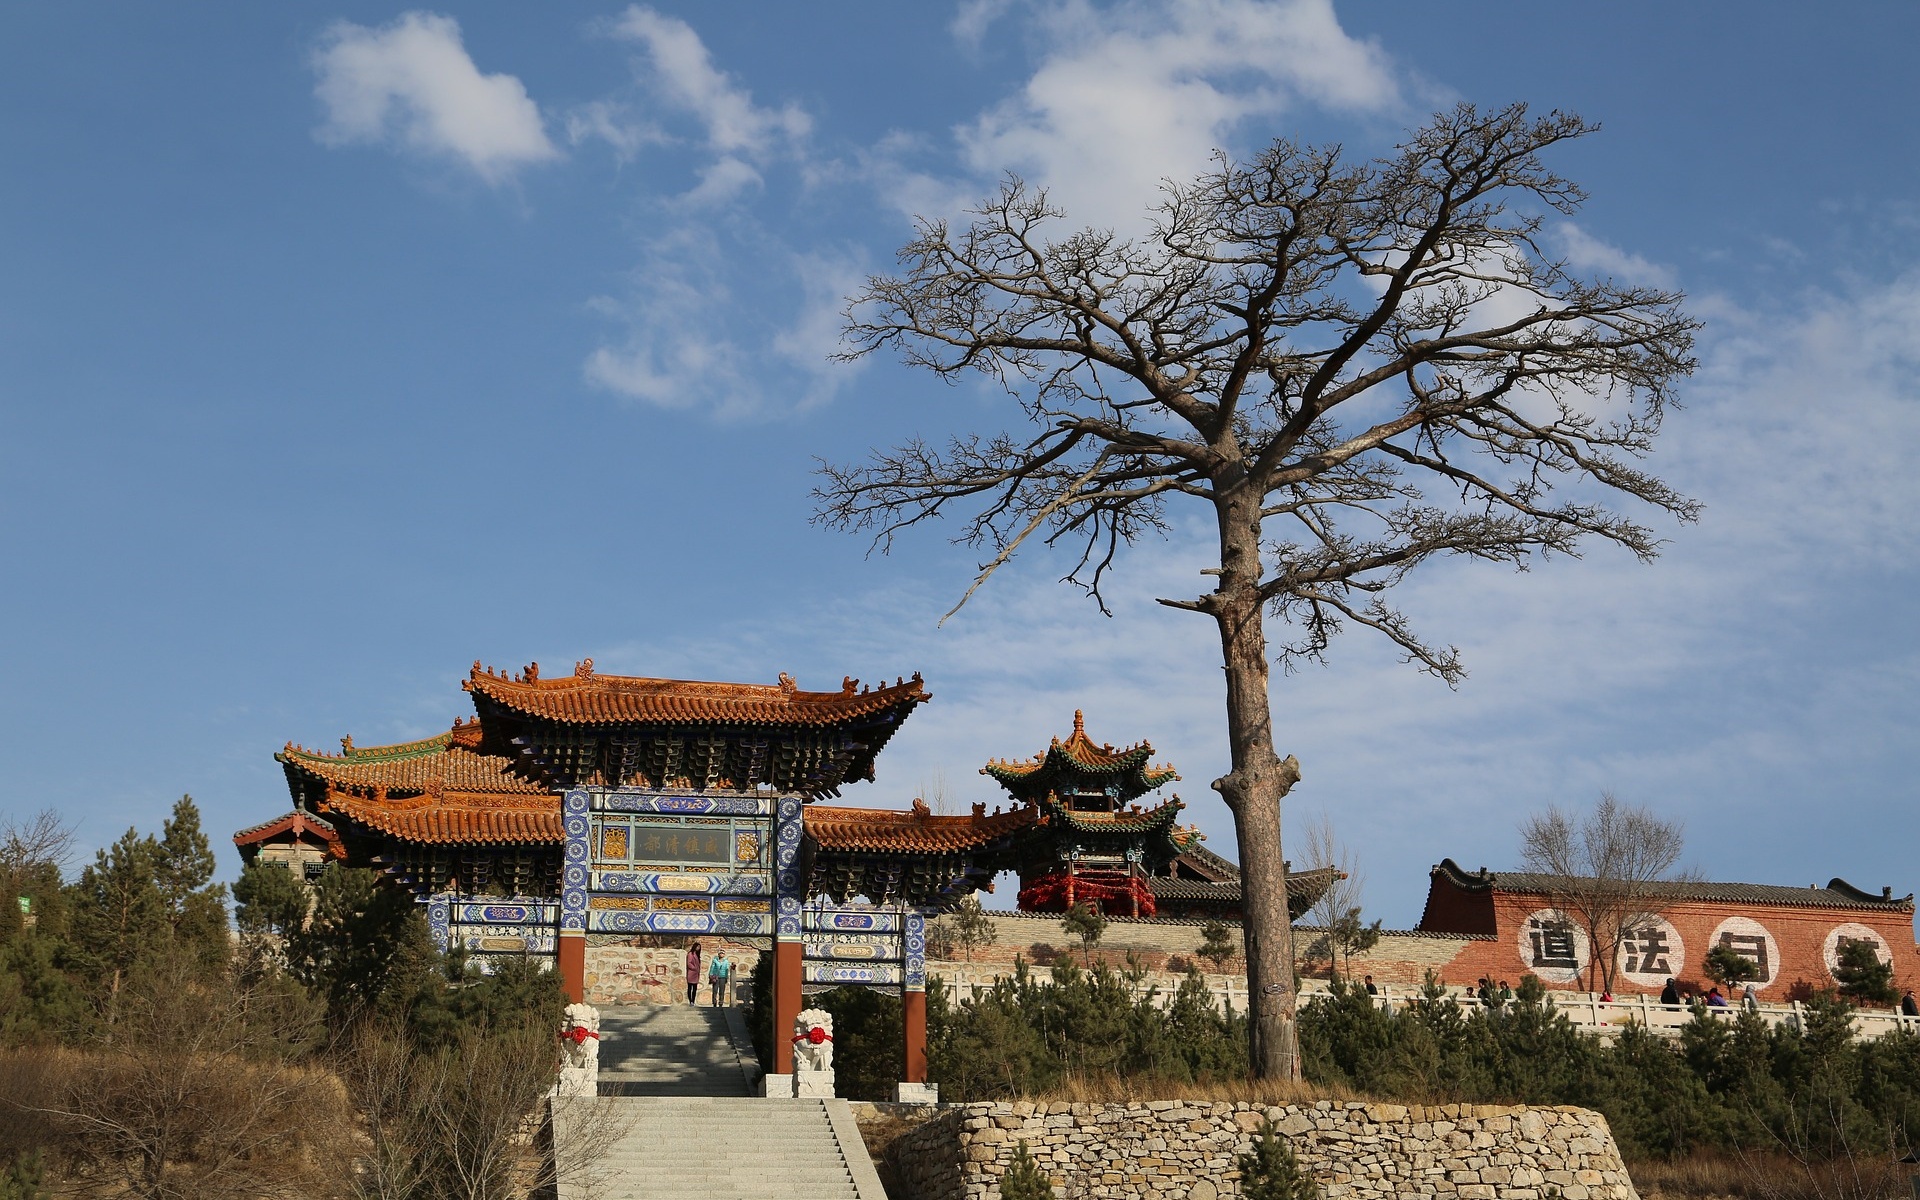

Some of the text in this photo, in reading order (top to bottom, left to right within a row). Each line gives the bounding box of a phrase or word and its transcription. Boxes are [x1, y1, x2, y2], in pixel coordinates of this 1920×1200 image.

[640, 962, 667, 977] 入口
[1529, 919, 1881, 983] 道法自
